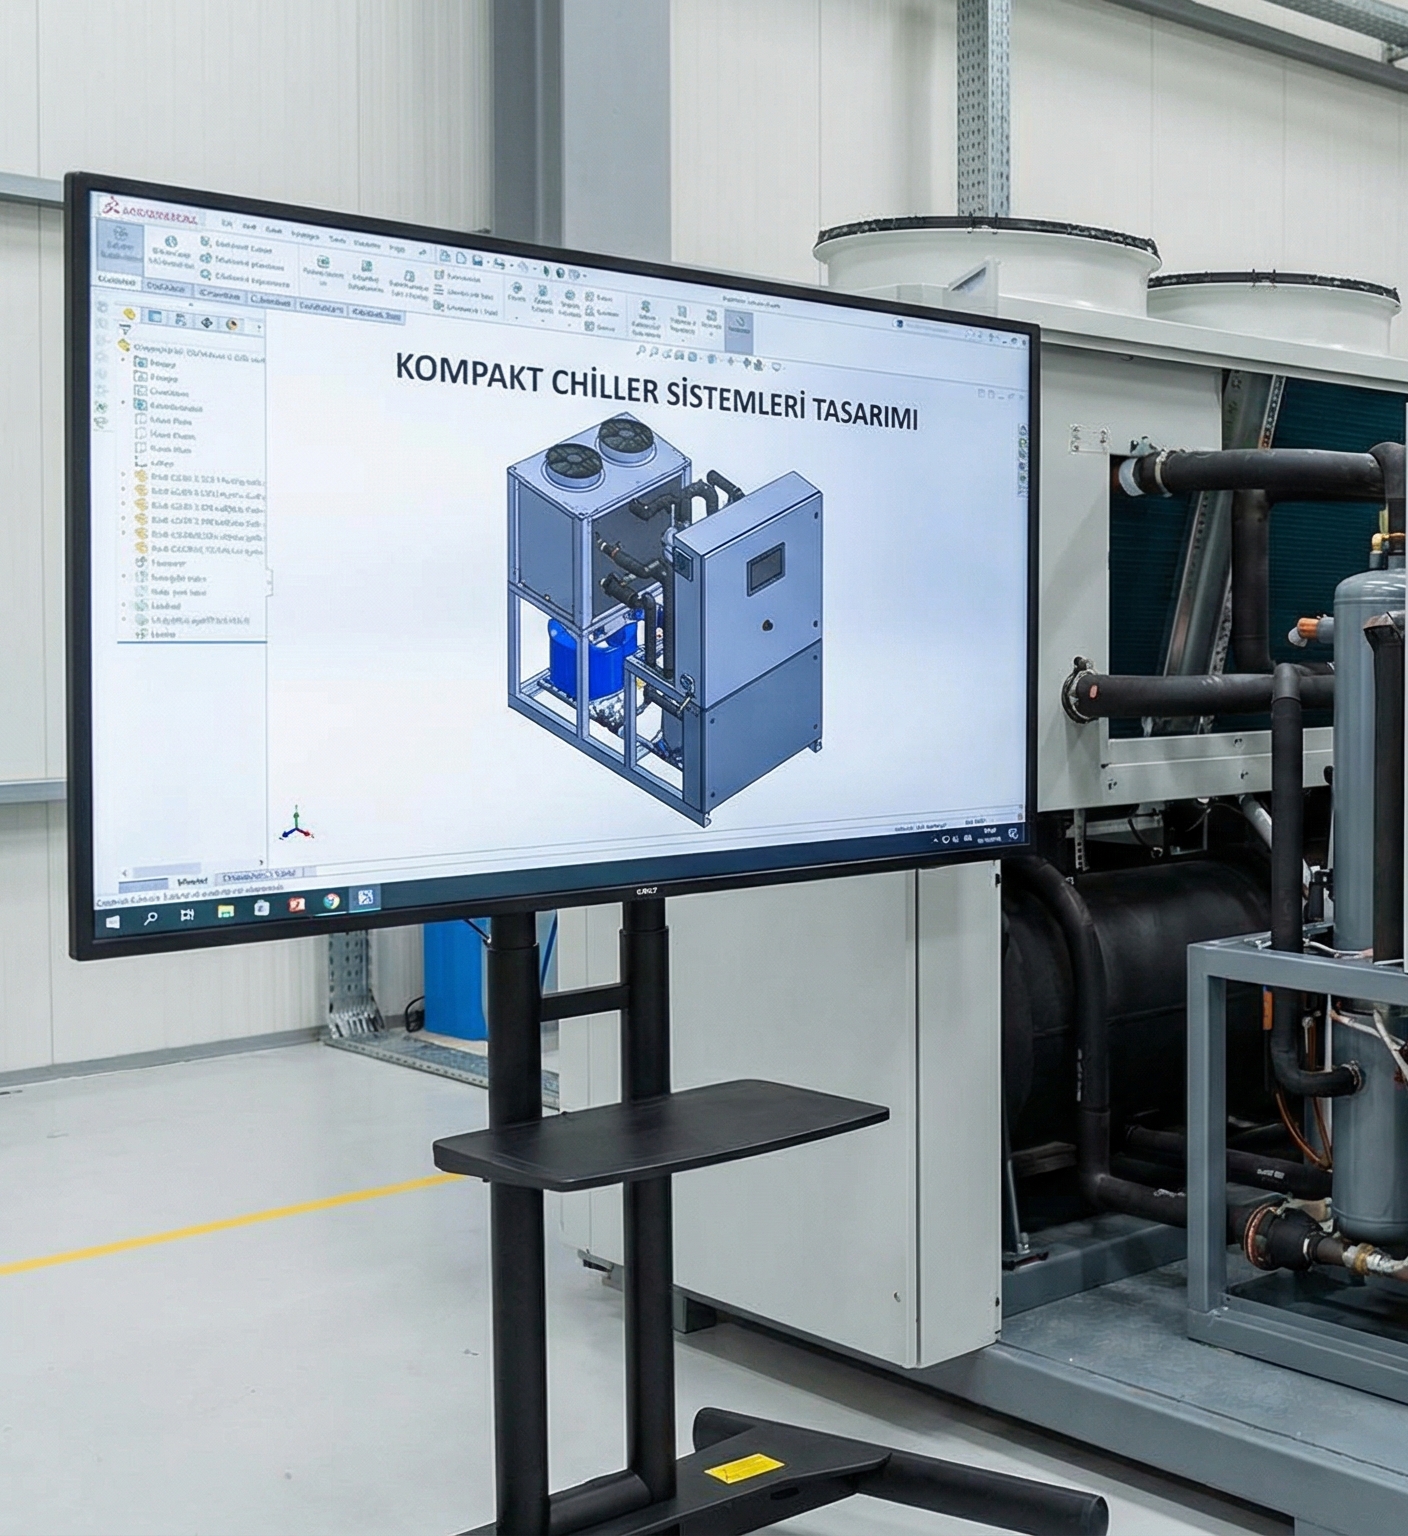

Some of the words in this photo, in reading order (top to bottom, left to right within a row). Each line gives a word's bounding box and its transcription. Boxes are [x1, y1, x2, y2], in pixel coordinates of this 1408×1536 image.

[396, 352, 544, 392] KOMPAKT
[552, 366, 659, 404] CHİLLER
[667, 376, 806, 420] SİSTEMLERİ
[812, 397, 919, 431] TASARIMI
